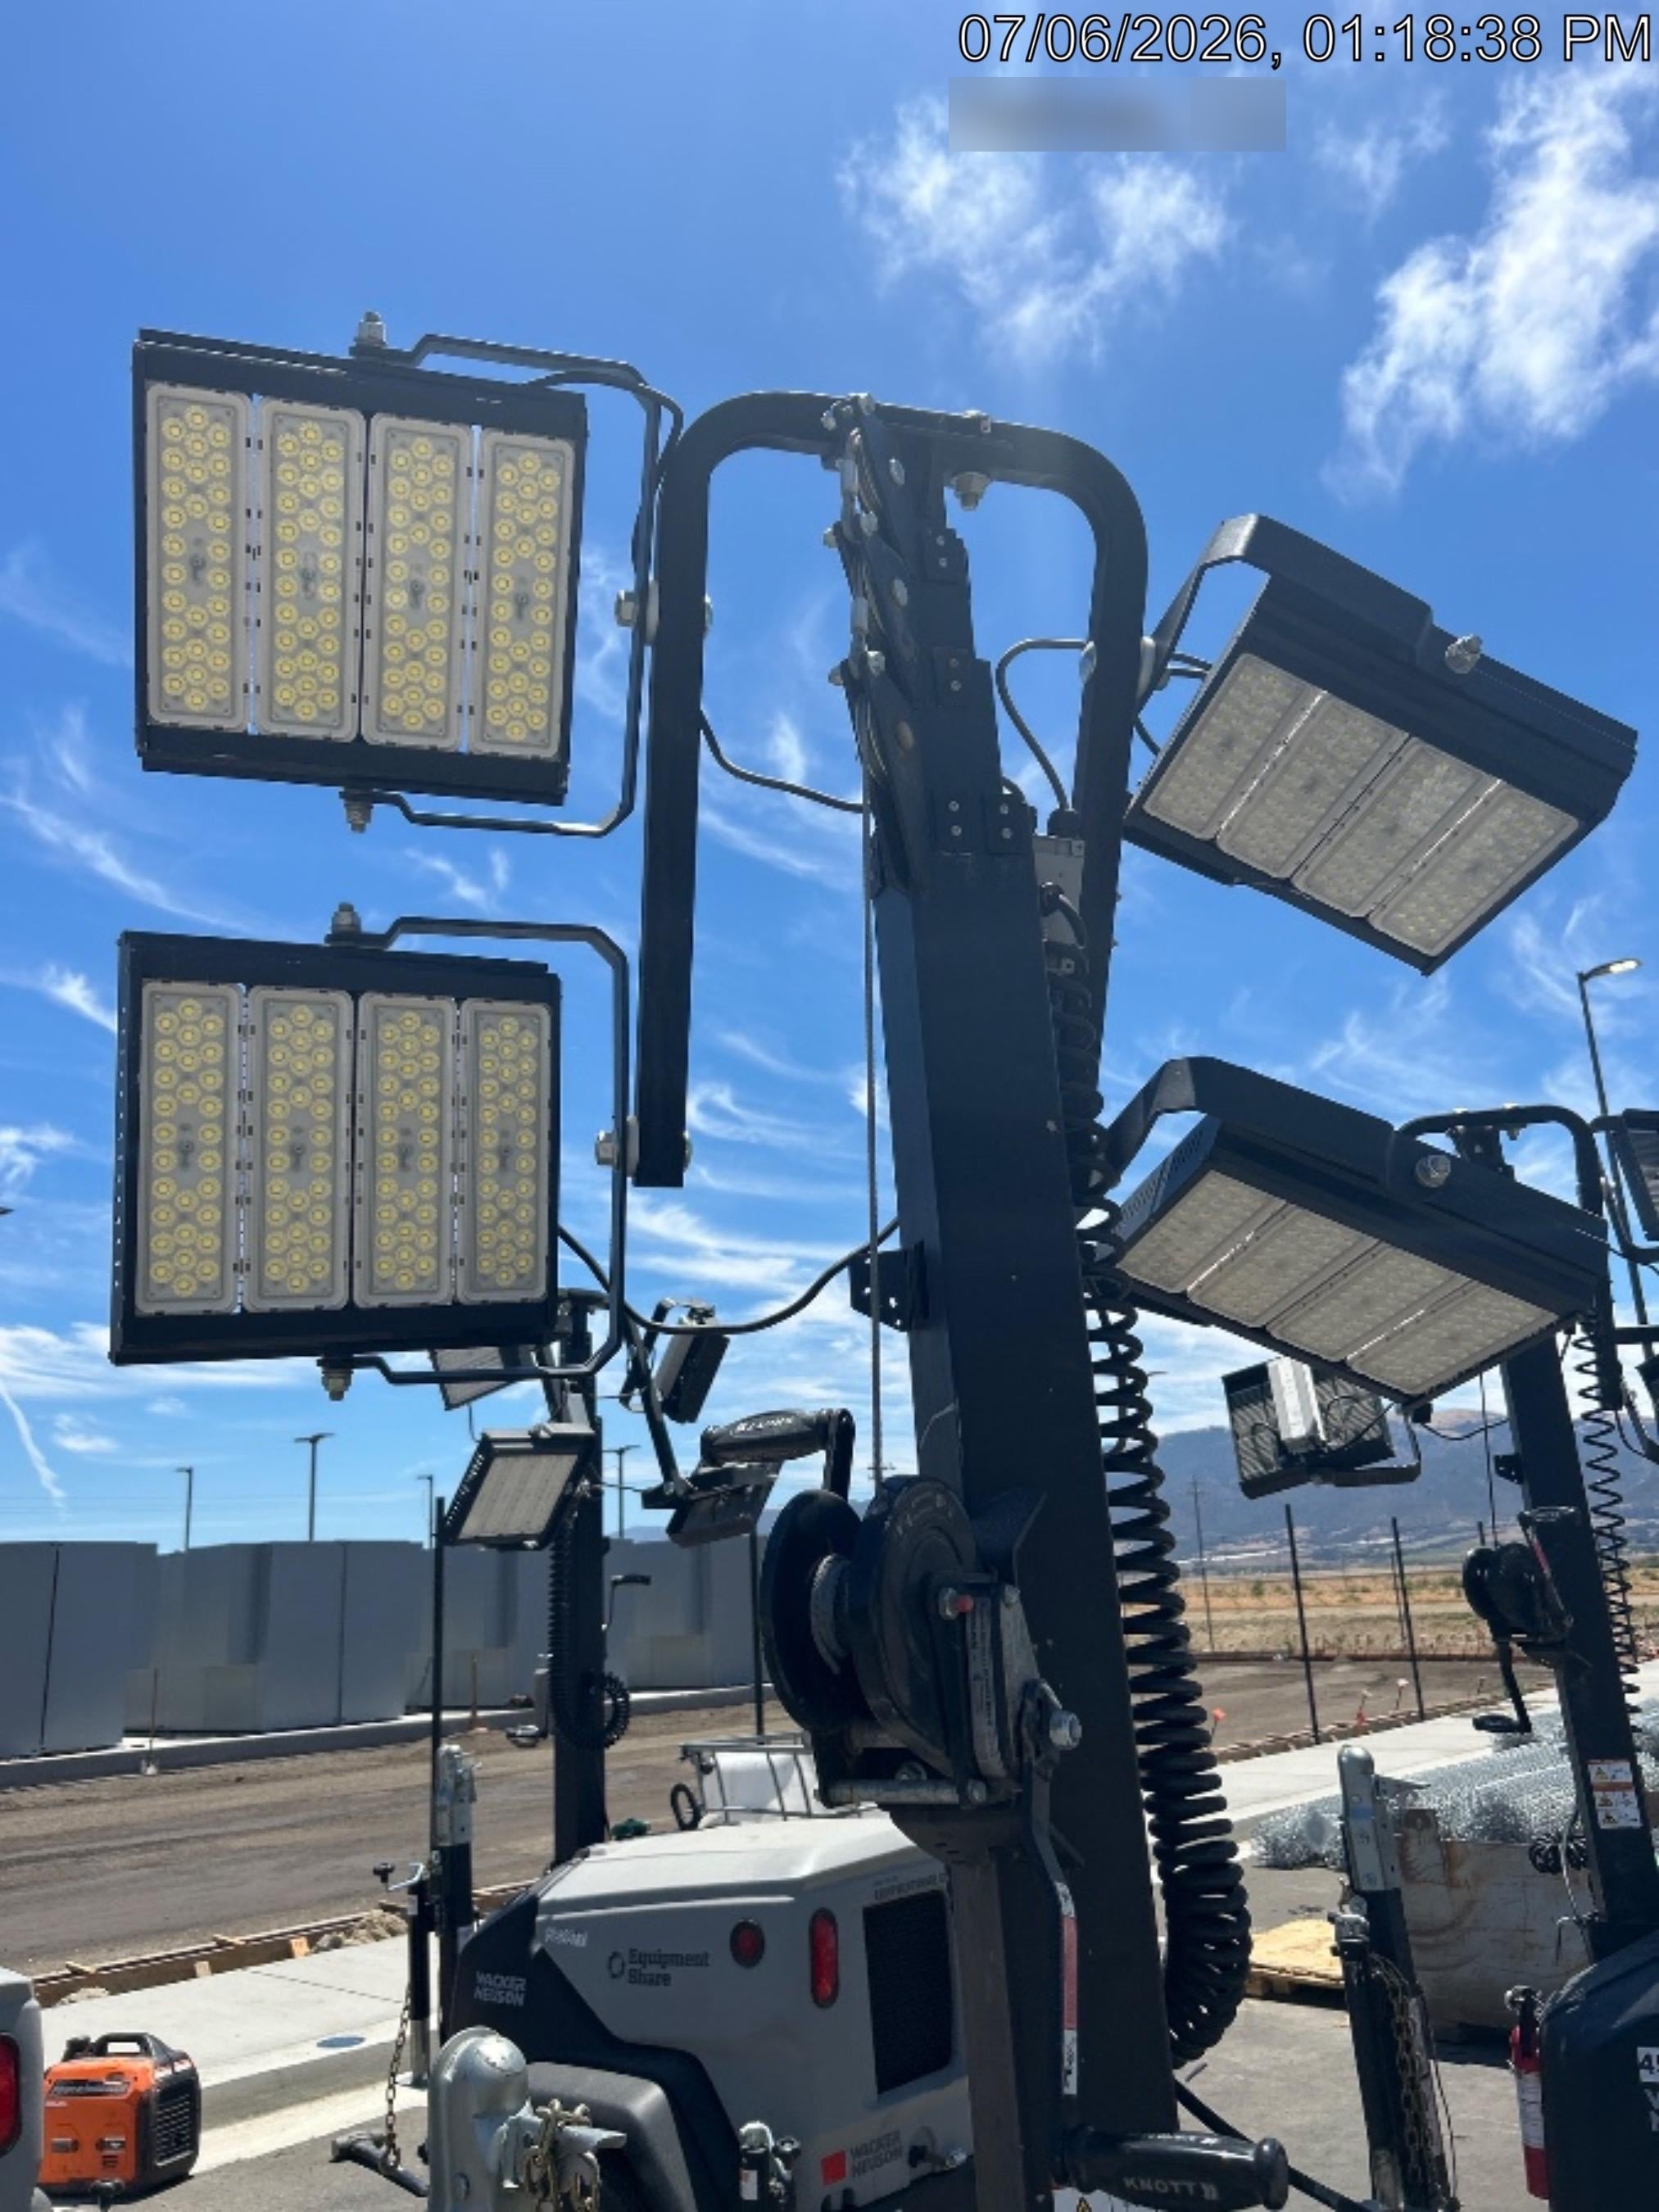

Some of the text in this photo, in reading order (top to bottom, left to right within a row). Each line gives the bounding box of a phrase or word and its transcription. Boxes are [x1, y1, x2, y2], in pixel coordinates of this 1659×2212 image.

[628, 1948, 710, 1969] Equipment
[475, 1970, 527, 1992] WACKER
[628, 1968, 672, 1987] Share
[473, 1985, 526, 2006] NEUSON
[1123, 2176, 1196, 2197] KNOTT
